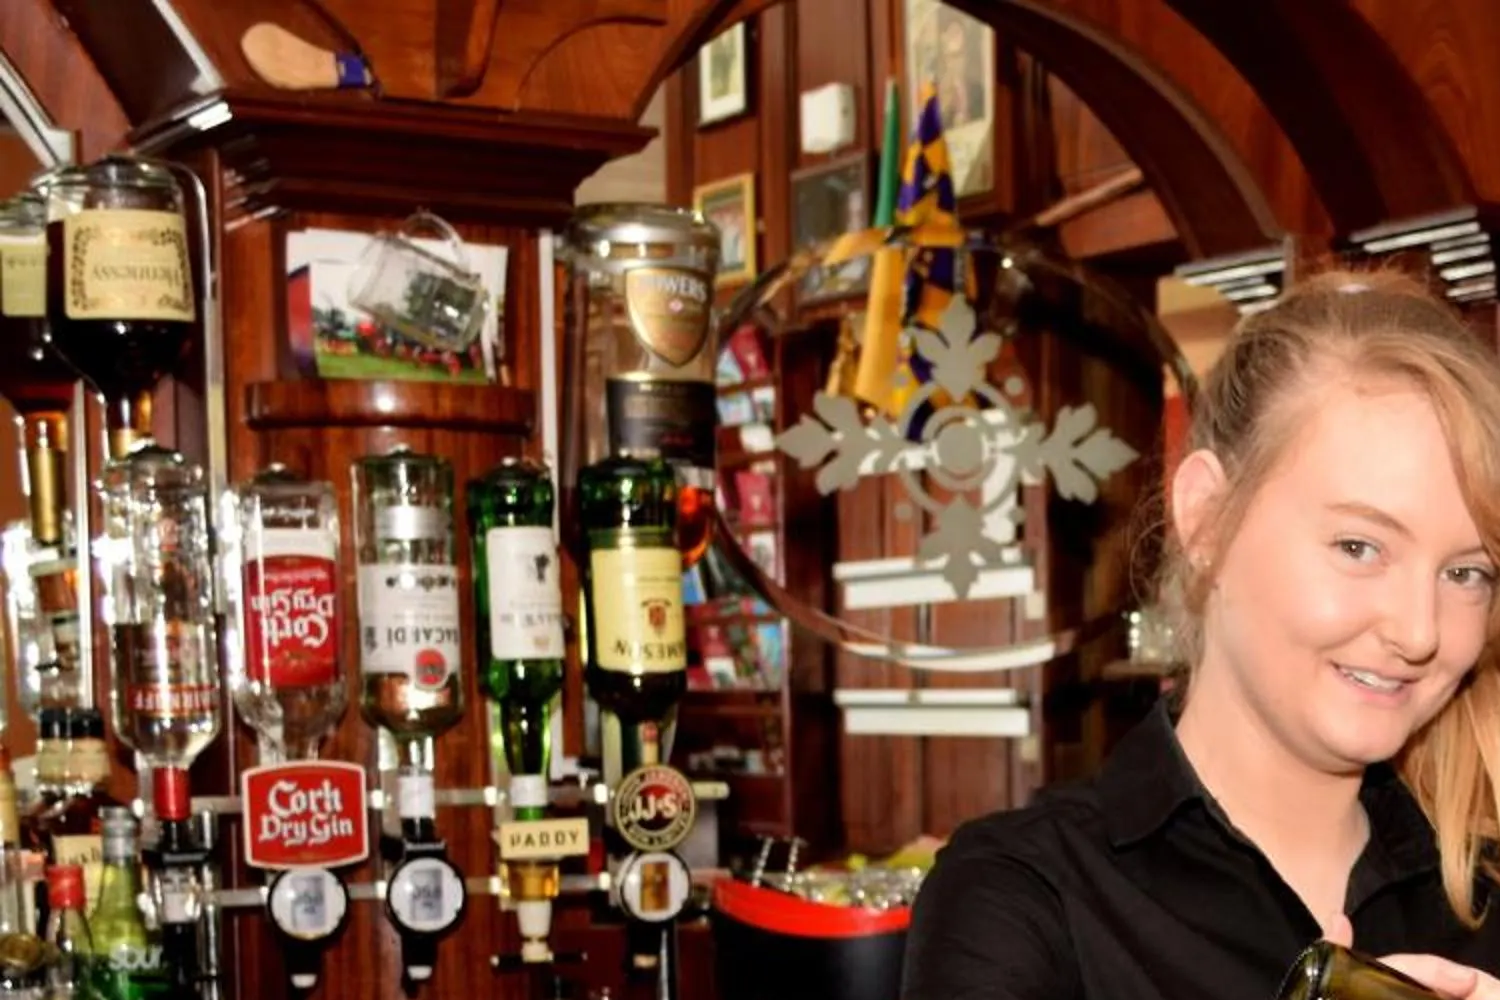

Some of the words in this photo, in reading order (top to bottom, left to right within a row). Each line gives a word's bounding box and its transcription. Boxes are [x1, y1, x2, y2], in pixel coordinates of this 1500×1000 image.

[267, 779, 344, 819] Cork
[258, 813, 307, 848] Dry
[307, 812, 354, 848] Gin
[509, 828, 580, 849] PADDY
